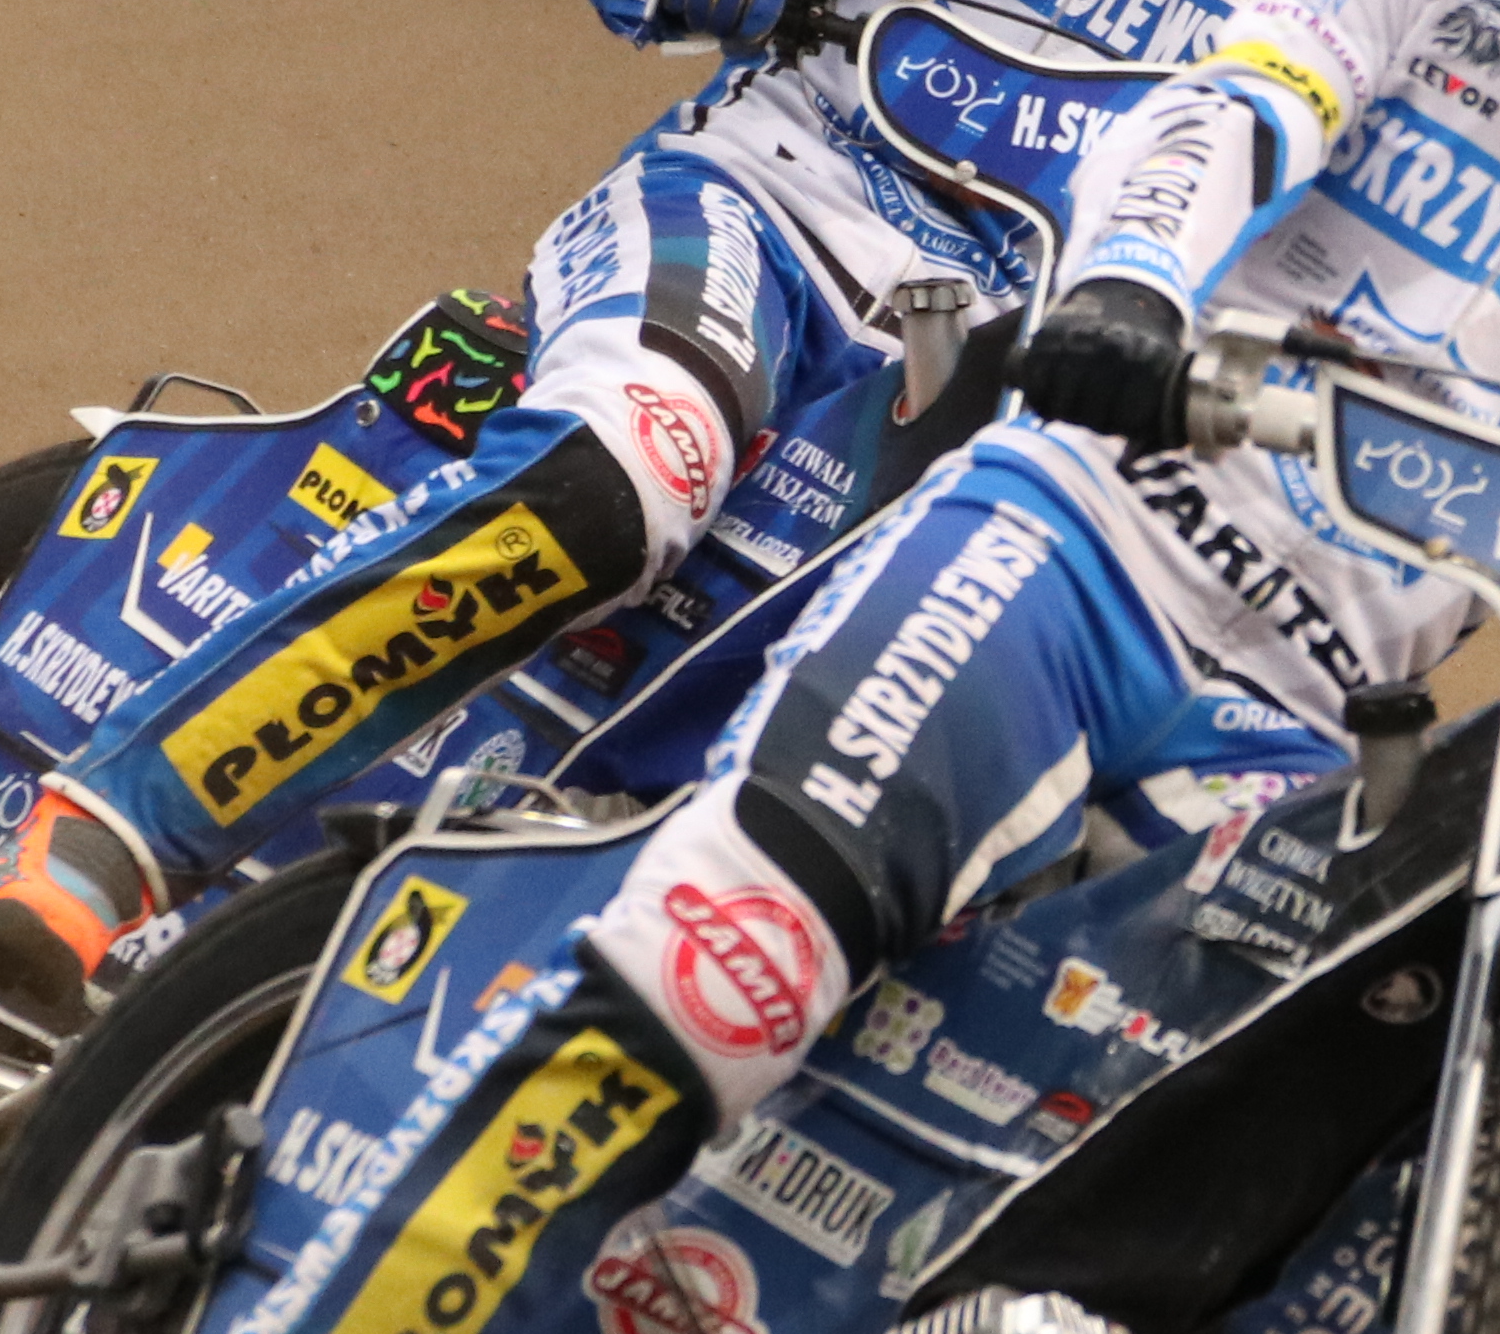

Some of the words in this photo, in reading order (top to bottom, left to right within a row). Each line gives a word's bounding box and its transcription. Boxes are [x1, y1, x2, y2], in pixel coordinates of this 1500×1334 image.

[1407, 56, 1500, 121] LEVOR
[624, 383, 709, 519] JAMIR
[202, 551, 562, 811] PŁOMYK
[664, 882, 803, 1059] JAMIR
